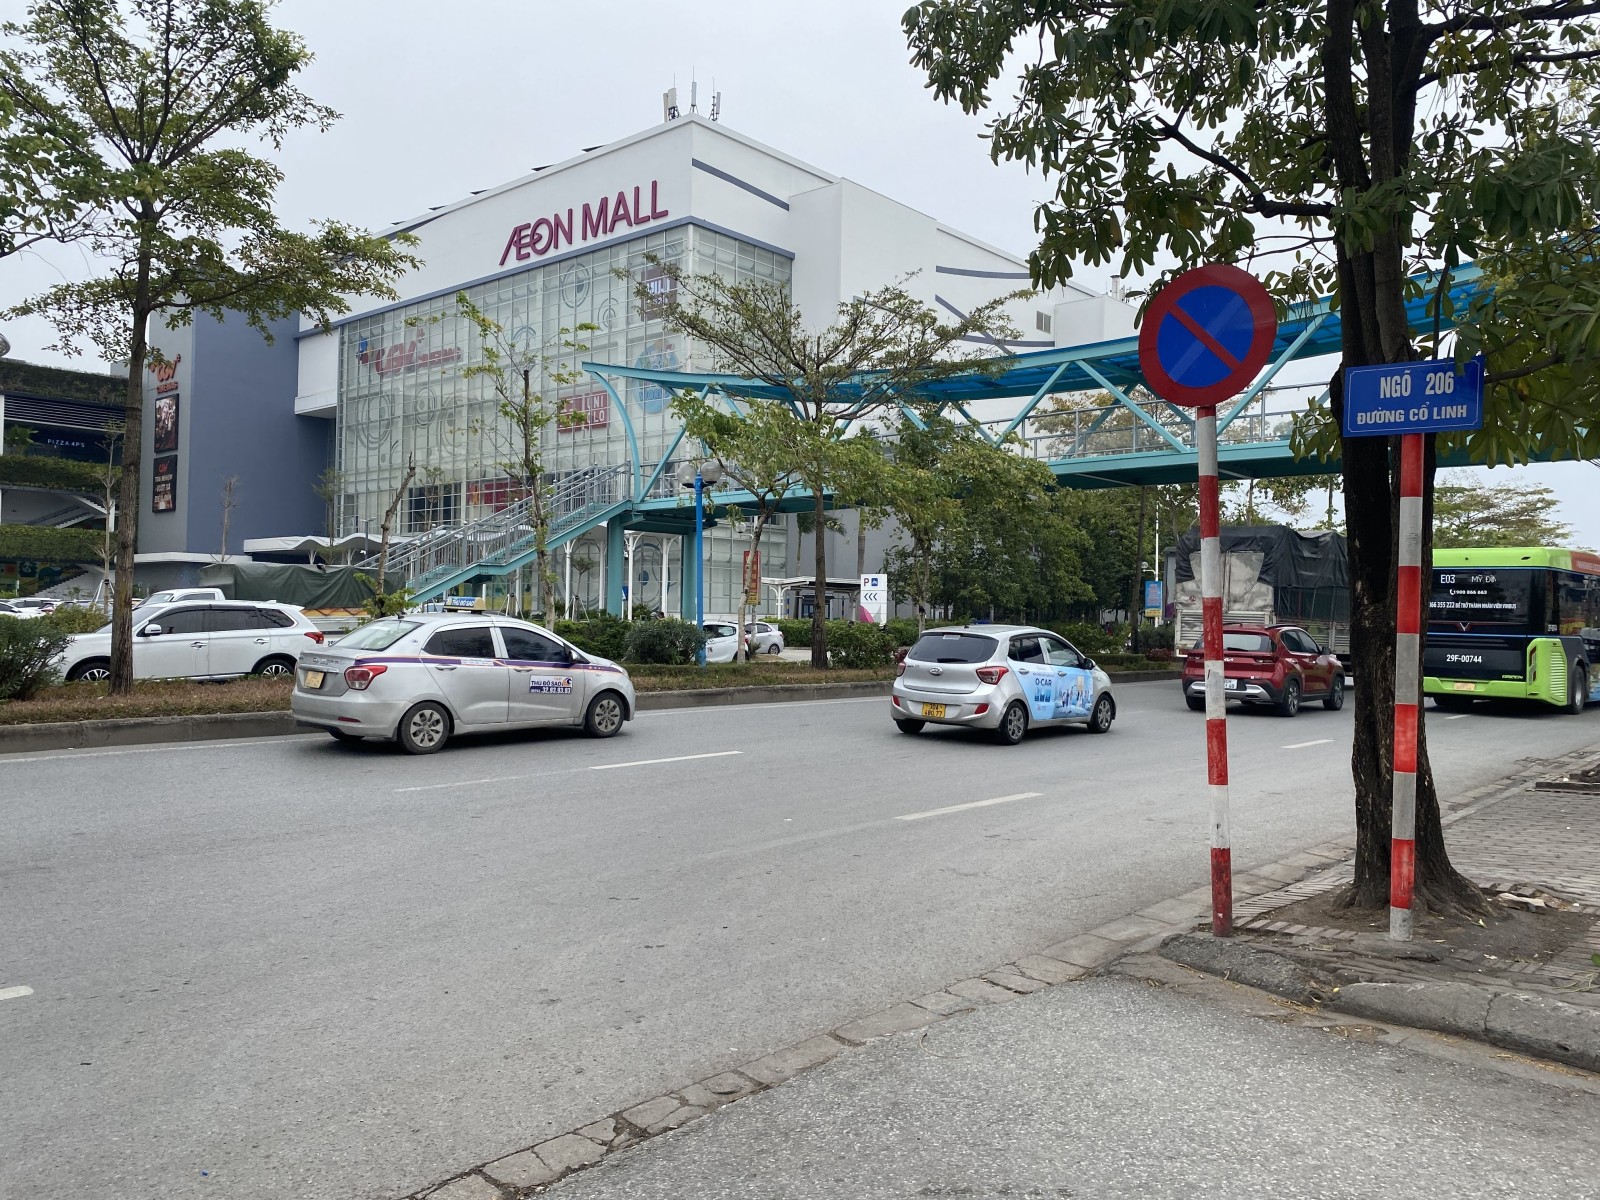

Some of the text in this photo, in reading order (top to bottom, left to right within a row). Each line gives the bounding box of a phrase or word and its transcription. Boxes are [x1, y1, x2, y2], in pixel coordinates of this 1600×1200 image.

[581, 179, 669, 241] MALL
[1380, 370, 1454, 398] NGÕ 206
[1357, 401, 1467, 425] ĐƯỜNG CỔ LINH
[47, 438, 69, 446] PIZZA
[863, 577, 870, 587] P
[1440, 574, 1456, 584] E03
[1446, 654, 1482, 663] 29F-00744
